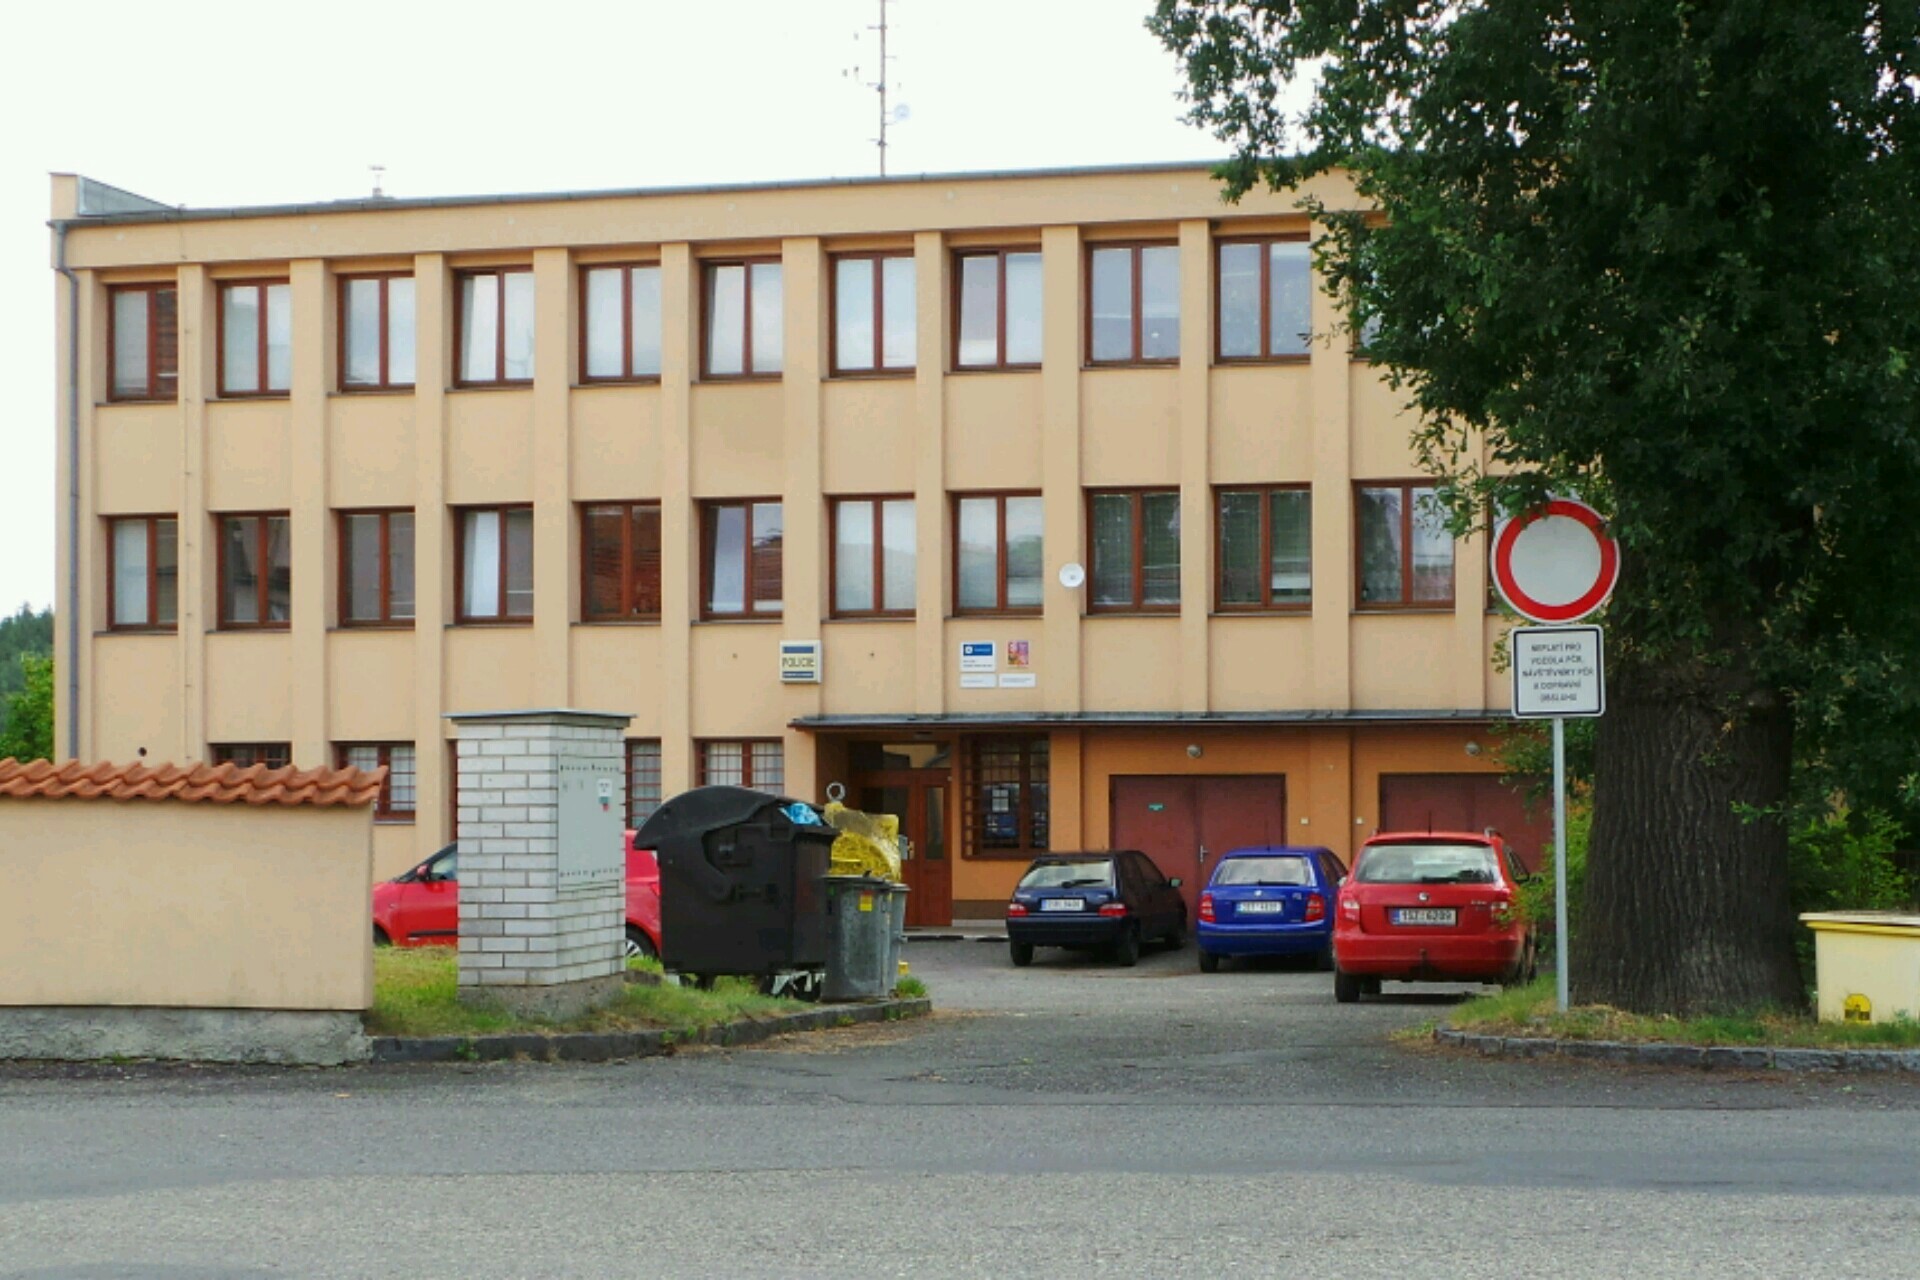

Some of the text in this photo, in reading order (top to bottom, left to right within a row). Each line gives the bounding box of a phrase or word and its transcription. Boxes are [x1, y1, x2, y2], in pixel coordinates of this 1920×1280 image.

[1531, 642, 1581, 652] NEPLATÍ PRO
[782, 657, 815, 668] POLICIE
